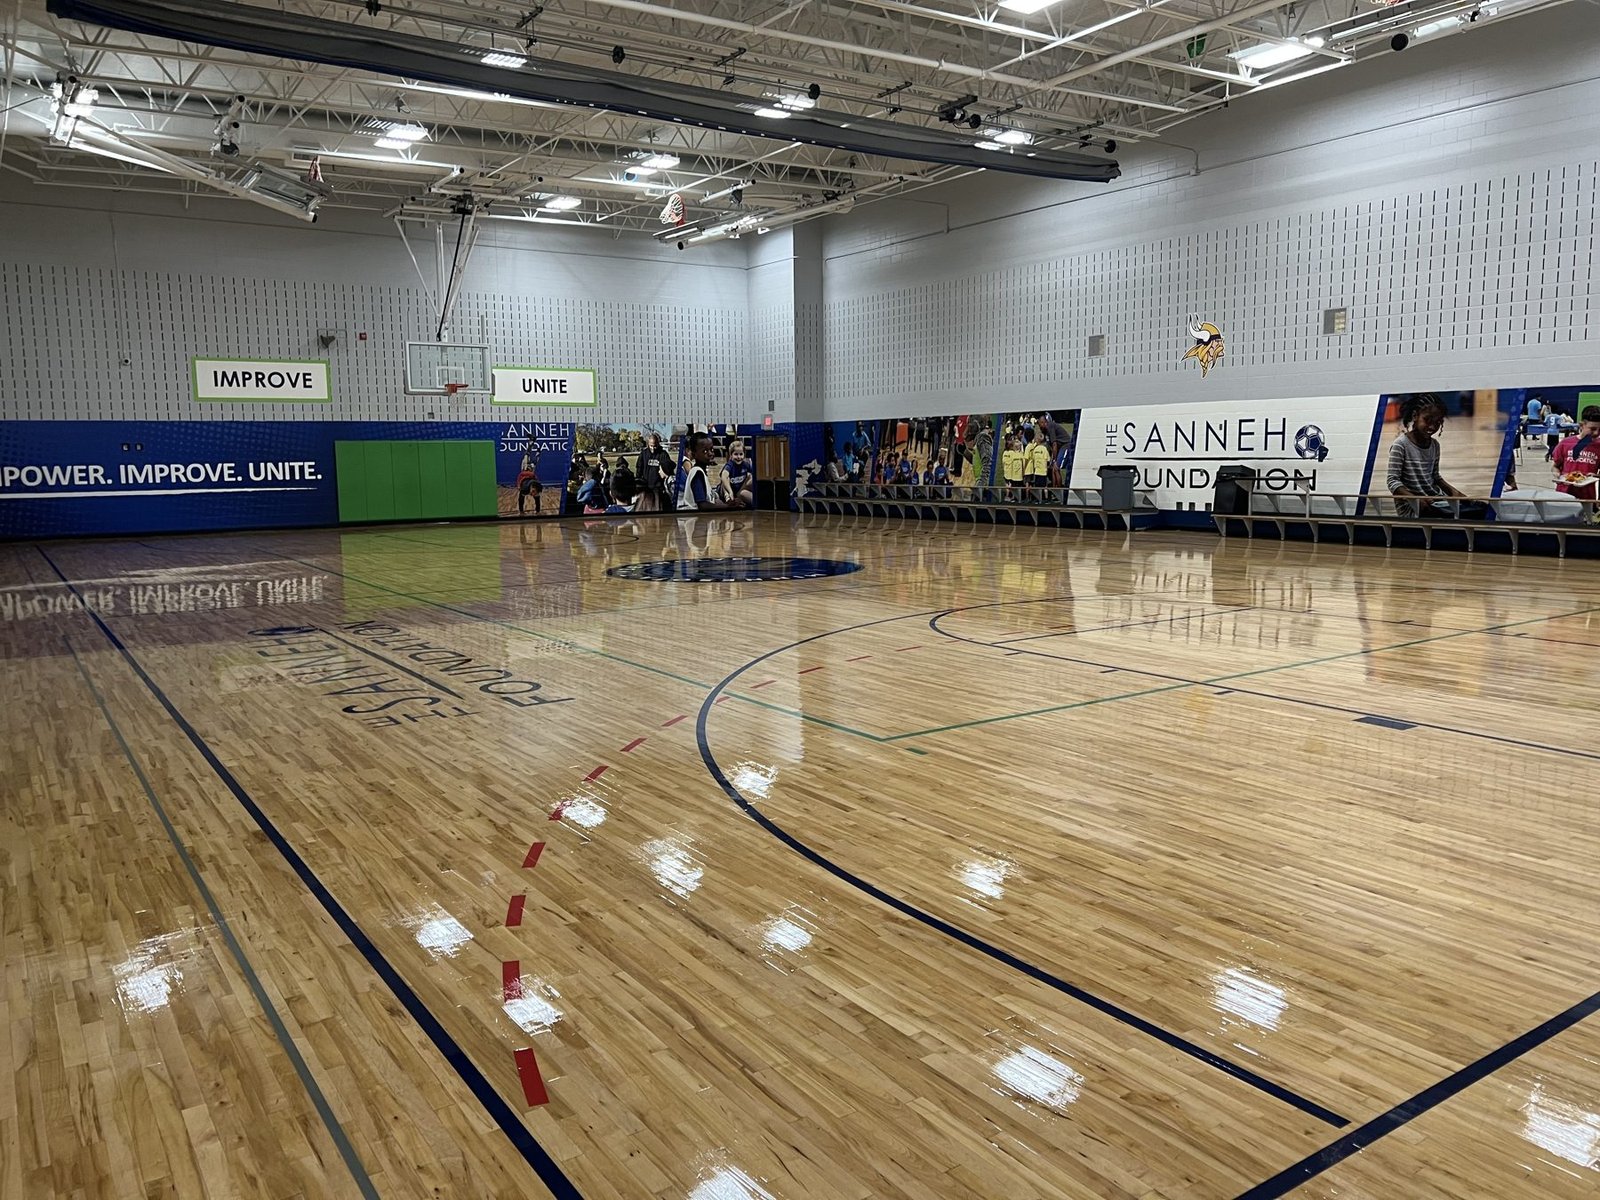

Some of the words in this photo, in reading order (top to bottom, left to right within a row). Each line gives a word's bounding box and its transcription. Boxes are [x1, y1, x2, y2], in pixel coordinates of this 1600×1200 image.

[213, 370, 313, 389] IMPROVE
[522, 378, 567, 394] UNITE
[502, 424, 569, 437] ANNEH
[1106, 424, 1118, 456] THE
[1122, 417, 1286, 453] SANNEH
[119, 463, 243, 484] IMPROVE.
[249, 461, 323, 481] UNITE.
[242, 634, 441, 714] SANNEH
[362, 706, 481, 729] THE
